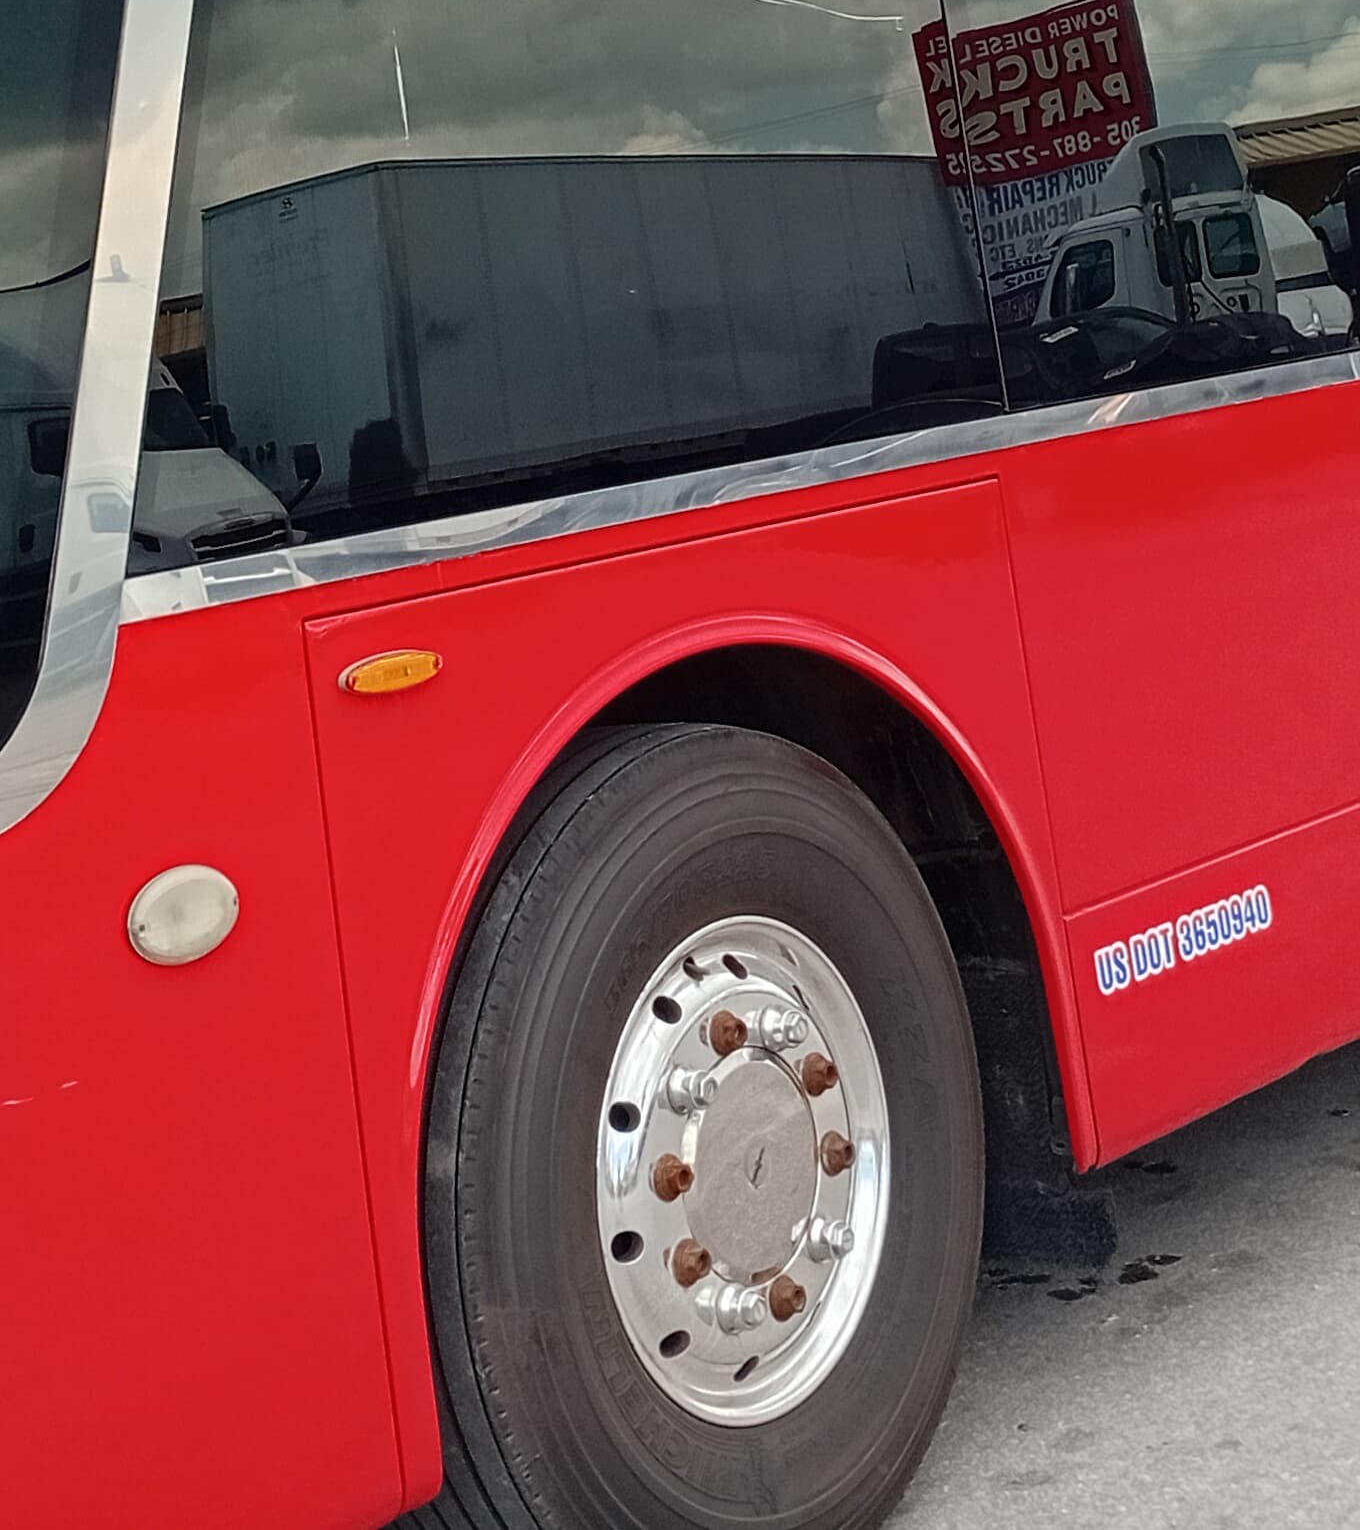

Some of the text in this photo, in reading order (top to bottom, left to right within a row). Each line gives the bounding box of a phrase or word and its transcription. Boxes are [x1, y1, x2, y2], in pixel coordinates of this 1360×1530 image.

[1095, 887, 1270, 992] US DOT 3650940
